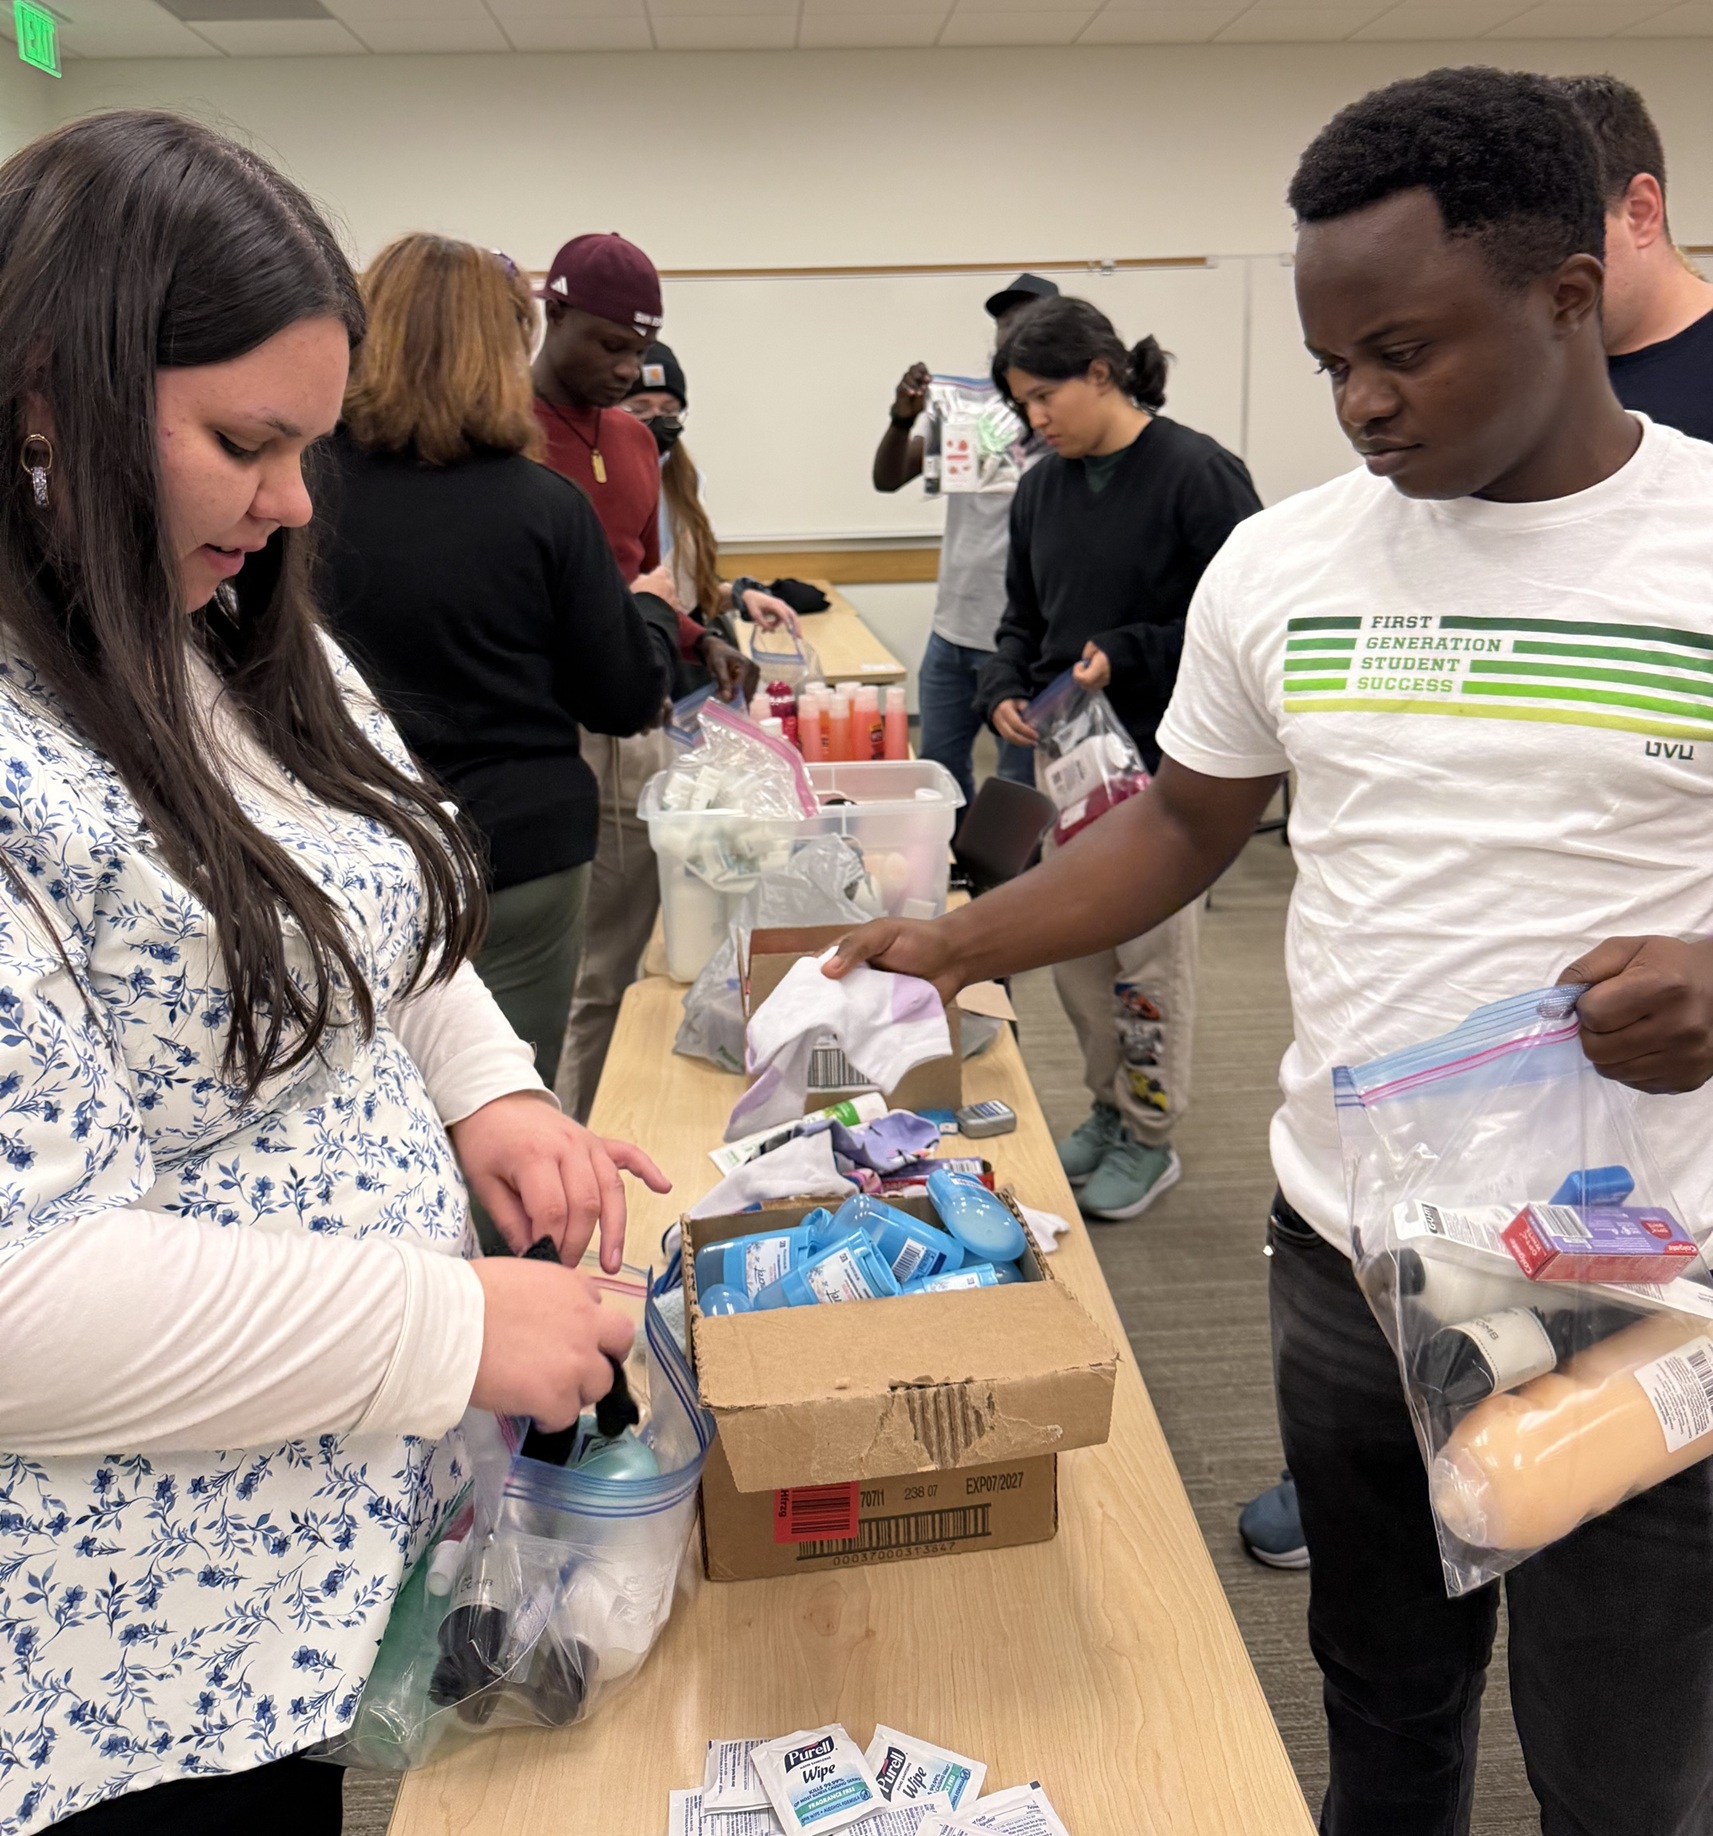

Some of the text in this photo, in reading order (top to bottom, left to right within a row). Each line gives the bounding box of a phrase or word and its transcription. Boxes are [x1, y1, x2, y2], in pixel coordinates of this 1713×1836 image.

[23, 9, 56, 70] EXIT
[1371, 615, 1433, 629] FIRST
[1365, 636, 1502, 652] GENERATION
[1361, 656, 1461, 673] STUDENT
[1357, 677, 1454, 693] SUCCESS
[1645, 740, 1694, 761] UVU
[1509, 1238, 1532, 1275] Colgate
[1667, 1243, 1698, 1255] Colgate
[904, 1486, 925, 1500] 238
[927, 1484, 938, 1497] 07
[966, 1471, 1024, 1495] EXP07/2027
[833, 1541, 956, 1566] 00037000313847
[788, 1740, 832, 1766] Purell
[803, 1763, 836, 1784] Wipe
[878, 1751, 905, 1793] Purell
[903, 1766, 927, 1799] Wipe
[930, 1773, 941, 1791] 99.99%
[808, 1785, 823, 1795] KILLS
[808, 1786, 855, 1809] FRAGRANCE FREE
[828, 1782, 847, 1793] CAUSING
[810, 1810, 820, 1819] WIPE
[824, 1802, 842, 1813] ALCOHOL
[842, 1795, 860, 1806] FORMULA
